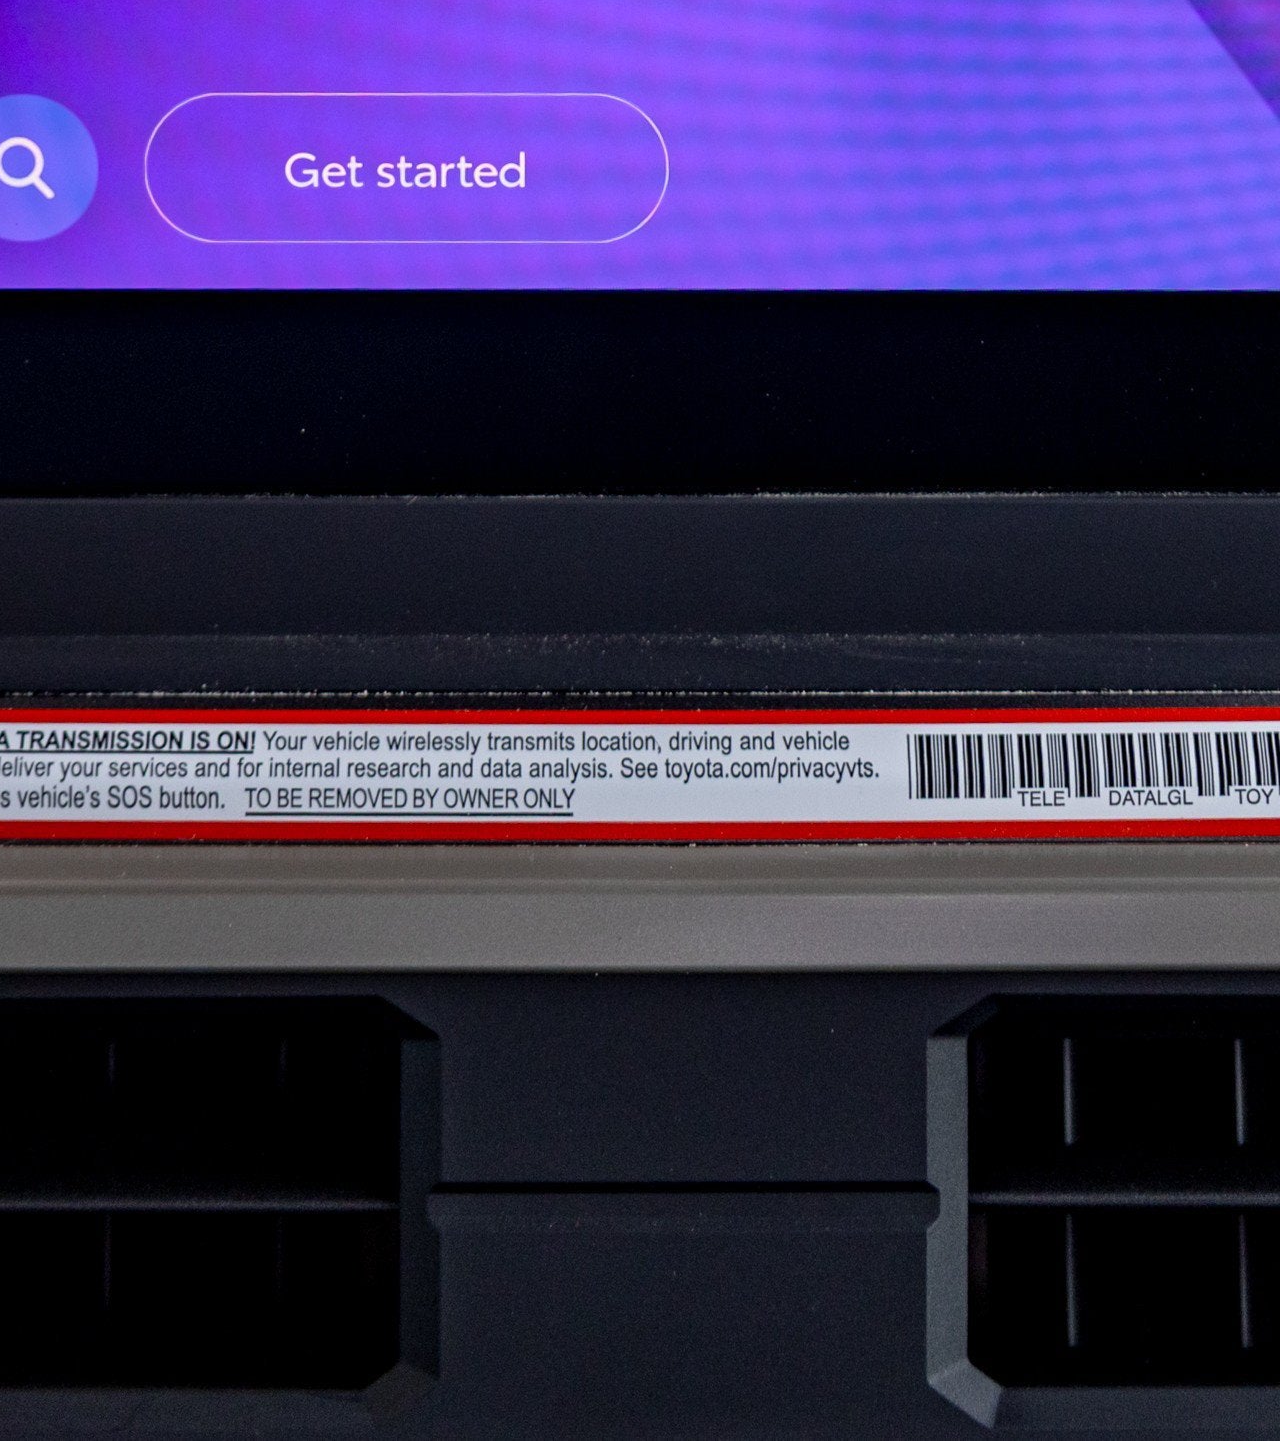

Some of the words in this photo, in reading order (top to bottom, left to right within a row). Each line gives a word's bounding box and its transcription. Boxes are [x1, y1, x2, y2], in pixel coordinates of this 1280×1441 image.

[283, 151, 364, 189] Get
[375, 151, 528, 189] started
[17, 730, 182, 750] TRANSMISSION
[188, 730, 210, 750] IS
[217, 730, 255, 750] ON!
[263, 731, 306, 751] Your
[313, 731, 381, 751] vehicle
[386, 731, 479, 755] wirelessly
[487, 731, 576, 751] transmits
[581, 731, 662, 754] location,
[669, 731, 732, 755] driving
[739, 731, 775, 751] and
[782, 731, 849, 751] vehicle
[60, 760, 102, 782] your
[109, 757, 188, 778] services
[195, 757, 230, 778] and
[237, 757, 263, 778] for
[269, 758, 340, 779] internal
[347, 758, 431, 779] research
[438, 758, 474, 779] and
[481, 758, 523, 779] data
[529, 758, 613, 783] analysis.
[620, 758, 658, 779] See
[664, 758, 879, 783] toyota.com/privacyvts.
[18, 786, 100, 809] vehicle's
[107, 787, 152, 809] SOS
[159, 787, 225, 809] button.
[246, 789, 271, 808] TO
[276, 789, 304, 808] BE
[309, 789, 408, 808] REMOVED
[413, 789, 439, 808] BY
[444, 789, 519, 808] OWNER
[524, 789, 574, 808] ONLY
[1019, 791, 1066, 806] TELE
[1109, 790, 1193, 806] DATALGL
[1235, 789, 1273, 804] TOY
